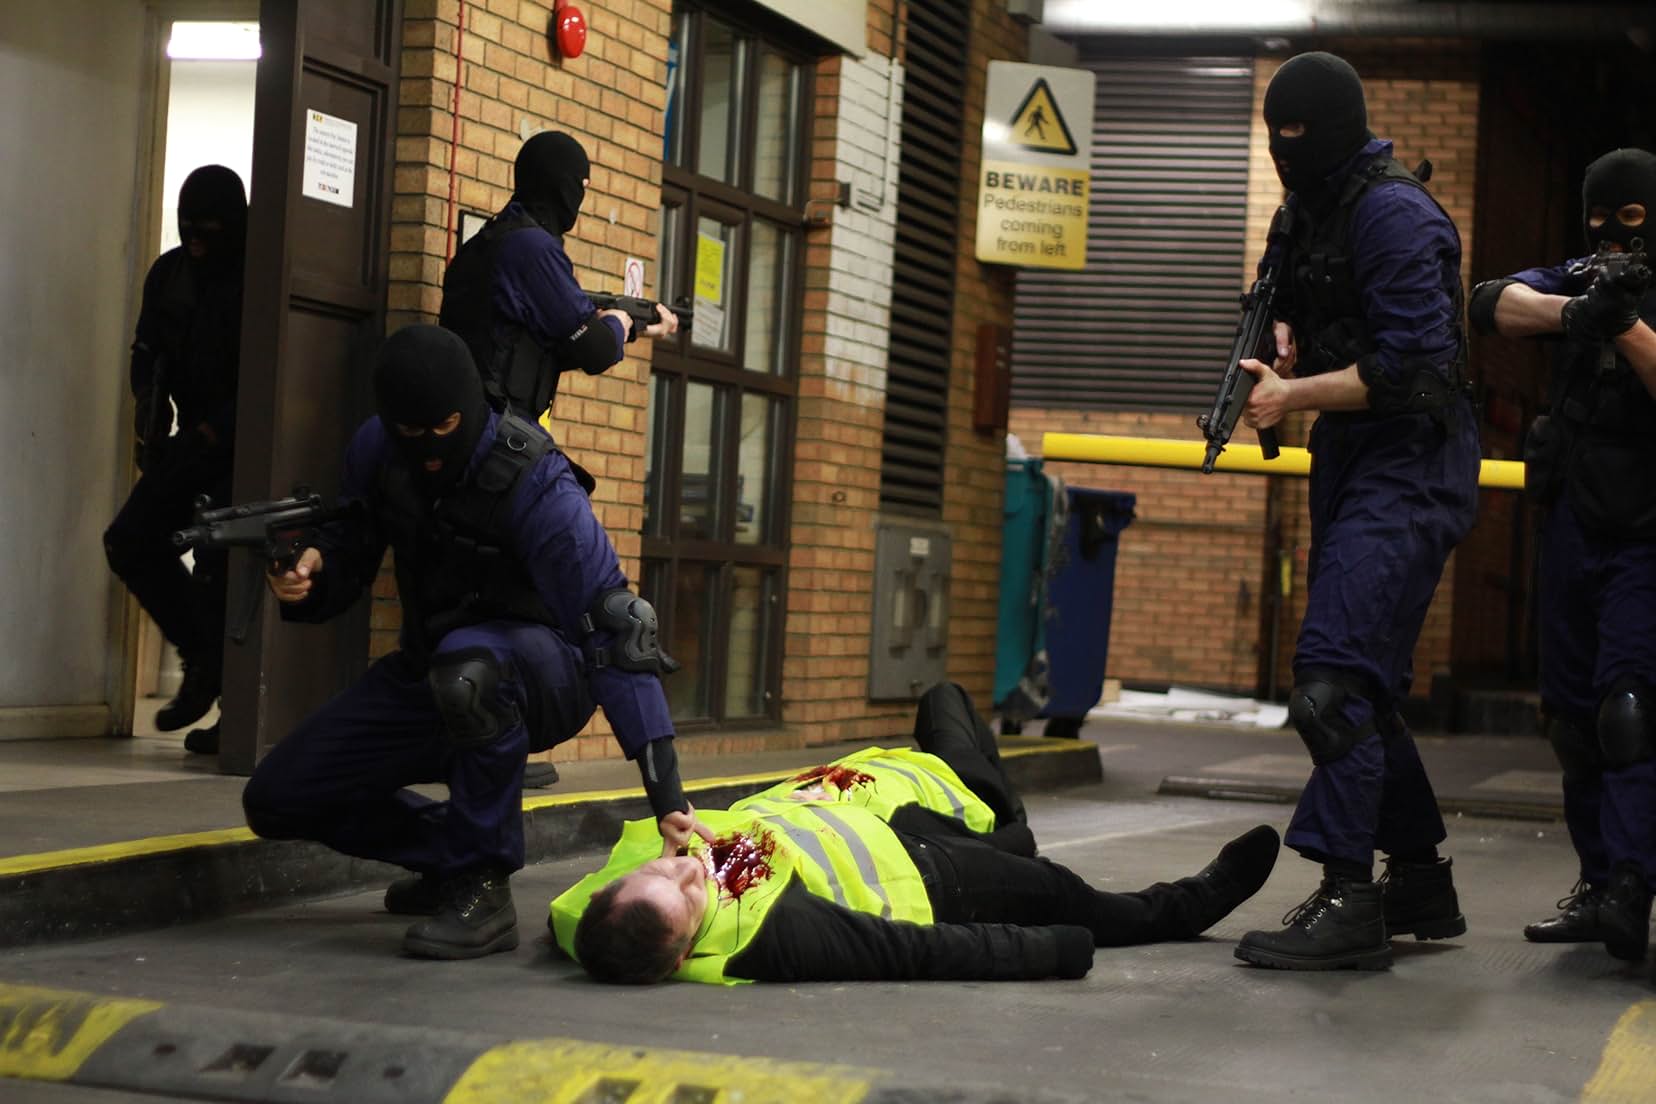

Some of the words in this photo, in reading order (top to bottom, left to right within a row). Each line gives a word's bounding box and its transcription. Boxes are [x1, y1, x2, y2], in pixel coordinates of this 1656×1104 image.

[986, 172, 1084, 197] BEWARE
[984, 194, 1082, 217] Pedestrians
[1000, 218, 1063, 237] coming
[997, 237, 1035, 255] from
[1041, 241, 1067, 257] left
